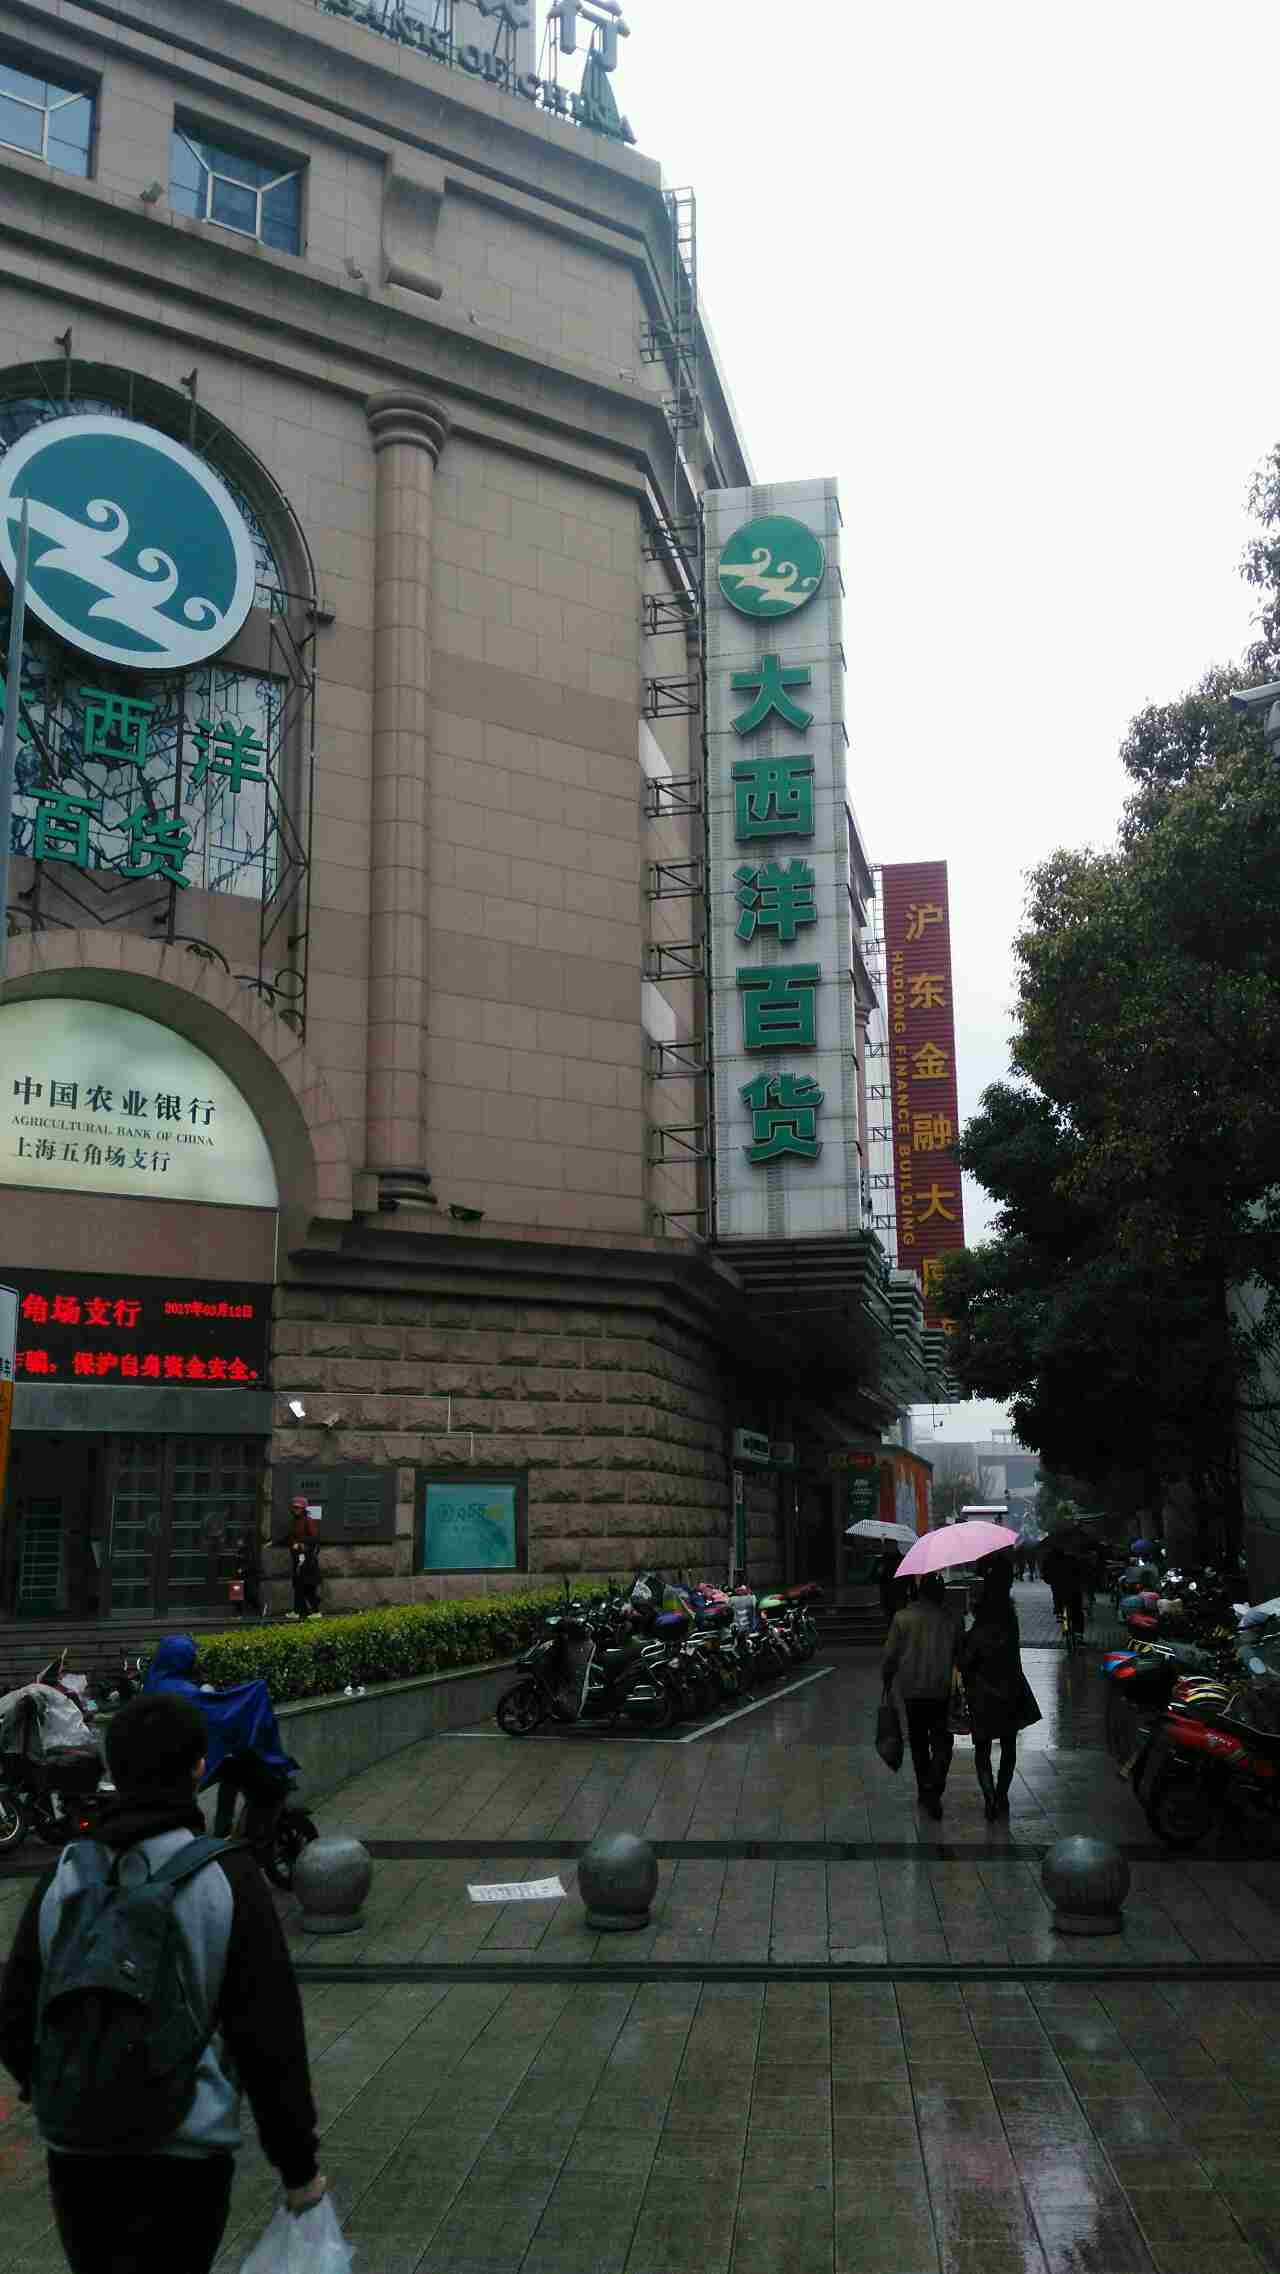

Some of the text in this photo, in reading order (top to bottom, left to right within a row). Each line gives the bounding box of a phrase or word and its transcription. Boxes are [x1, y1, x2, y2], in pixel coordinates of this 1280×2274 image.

[26, 786, 192, 889] 百货
[728, 653, 827, 1163] 大西洋百货
[12, 1115, 215, 1147] AGRICULTURAL BANK OF CHINA
[13, 1075, 216, 1126] 中国农业银行
[892, 951, 916, 1246] HUDONG FINANCE BUILDING
[16, 1136, 171, 1173] 上海五角场支行
